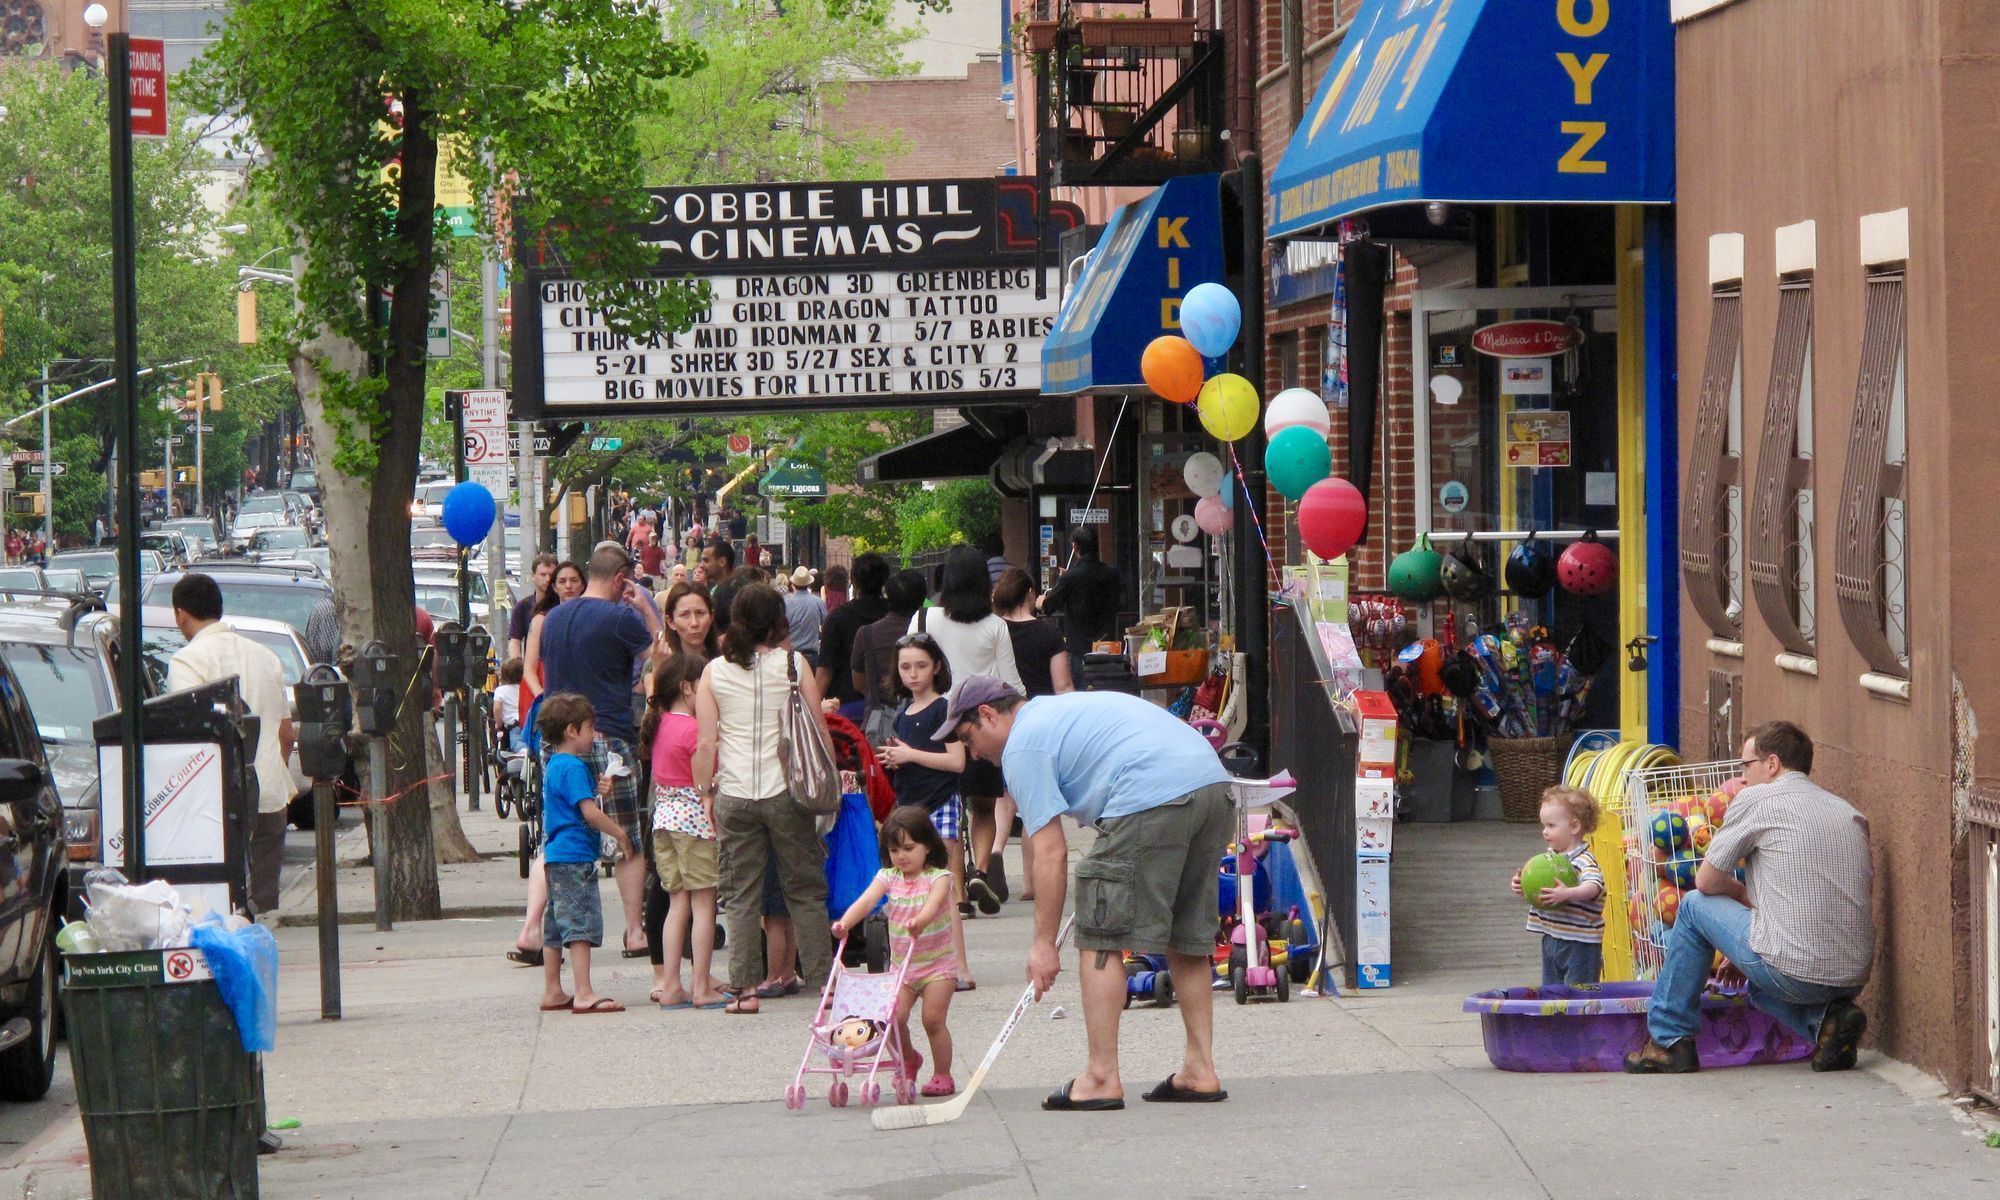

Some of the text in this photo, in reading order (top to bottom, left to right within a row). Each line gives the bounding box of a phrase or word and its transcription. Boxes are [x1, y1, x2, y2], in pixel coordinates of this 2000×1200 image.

[861, 185, 972, 218] HILL
[691, 223, 922, 260] CINEMAS
[736, 275, 829, 297] DRAGON
[847, 273, 873, 294] 3D
[897, 268, 1029, 292] GREENBERG
[733, 301, 786, 323] GIRL
[797, 298, 890, 321] DRAGON
[906, 294, 998, 317] TATTOO
[571, 330, 630, 351] THUR
[694, 327, 737, 349] MID
[752, 324, 857, 347] IRONMAN
[868, 323, 881, 343] 2
[914, 320, 952, 341] 5/7
[970, 316, 1054, 339] BABIES
[1481, 332, 1530, 350] Melissa
[596, 343, 1018, 375] 5-21 SHREK 3D 5/27 SEX & CITY 2
[605, 379, 644, 400] BIG
[656, 376, 743, 398] MOVIES
[755, 375, 797, 396] FOR
[808, 372, 891, 394] LITTLE
[910, 369, 964, 391] KIDS
[979, 367, 1017, 388] 5/3
[464, 409, 498, 417] ANYTIME
[473, 396, 502, 405] PARKING
[83, 966, 95, 976] New
[96, 965, 114, 975] York
[116, 964, 132, 976] City
[134, 963, 158, 973] Clean
